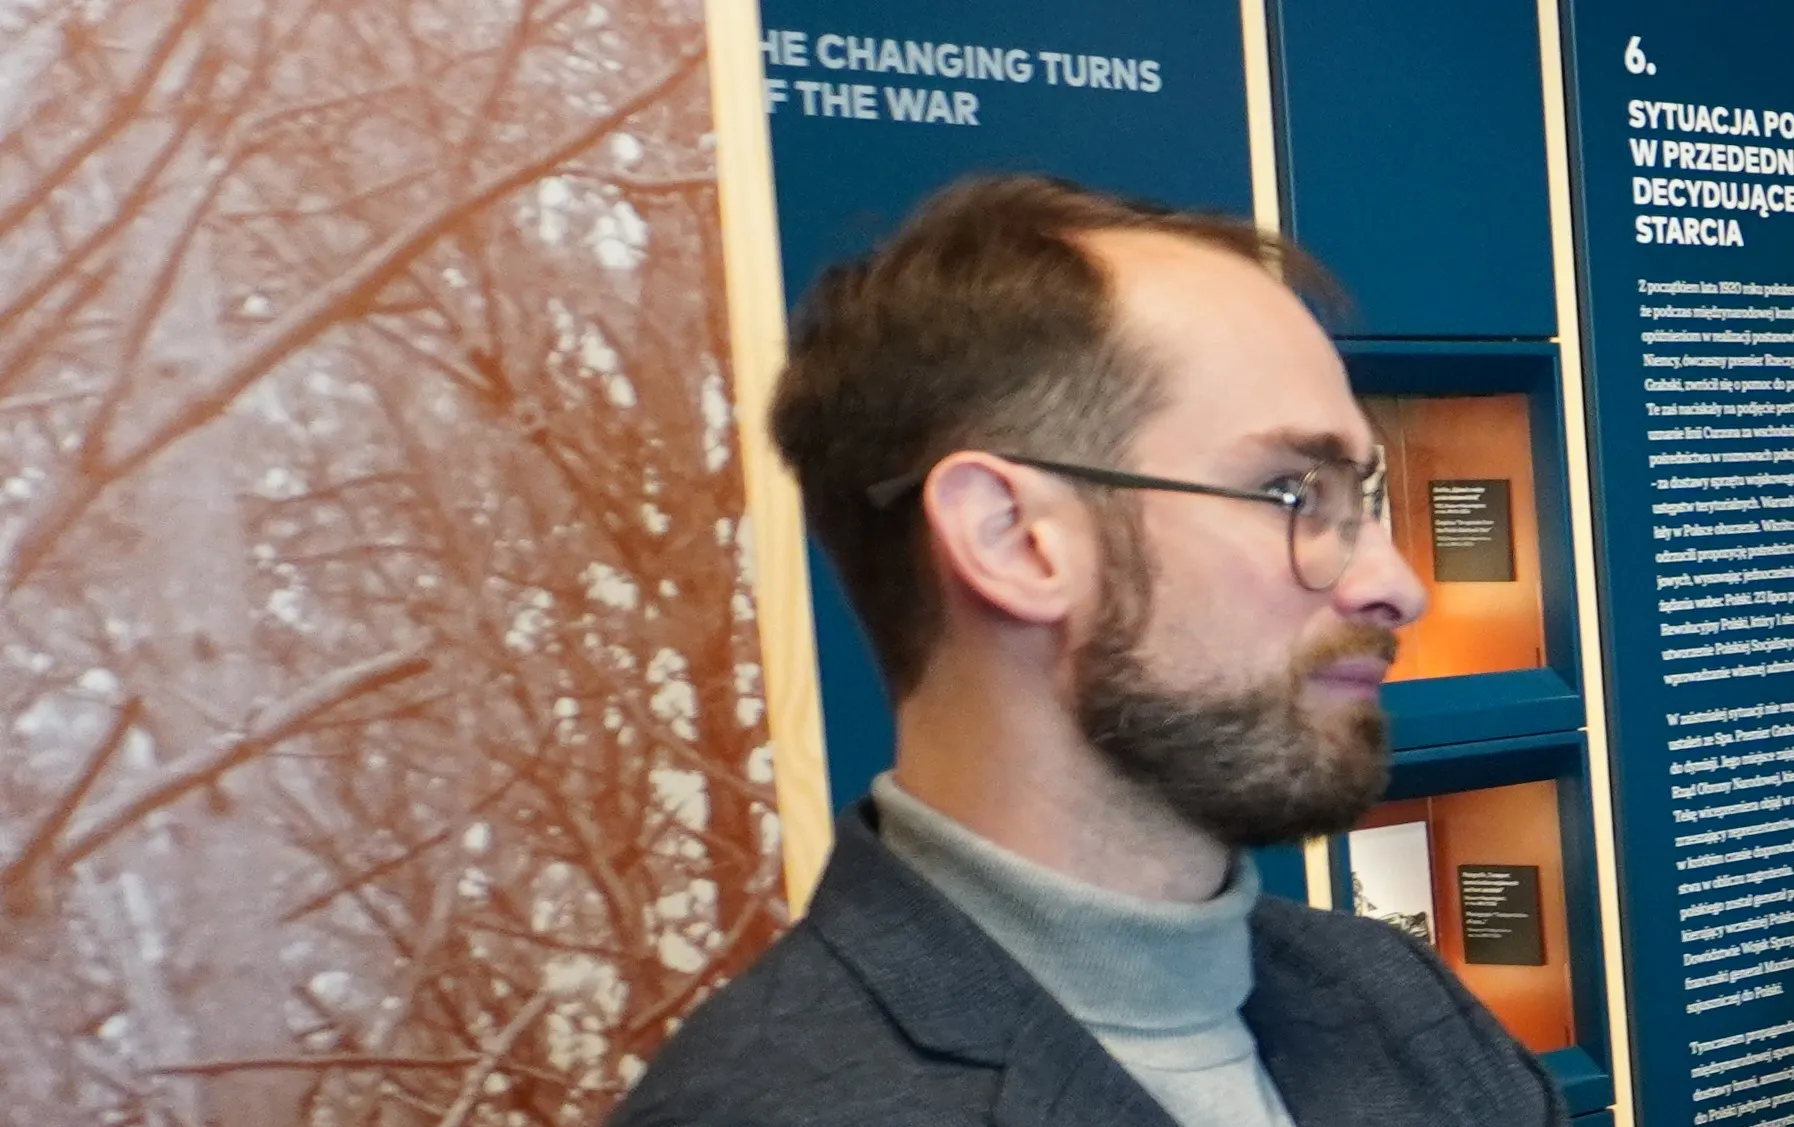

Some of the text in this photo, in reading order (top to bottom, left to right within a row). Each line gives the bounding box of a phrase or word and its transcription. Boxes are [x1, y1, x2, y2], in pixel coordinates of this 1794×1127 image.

[760, 30, 1163, 93] HE CHANGING TURNS
[1625, 36, 1656, 75] 6.
[765, 79, 979, 126] F THE WAR
[1628, 100, 1760, 136] SYTUACJA
[1630, 138, 1657, 167] W
[1636, 215, 1744, 246] STARCIA
